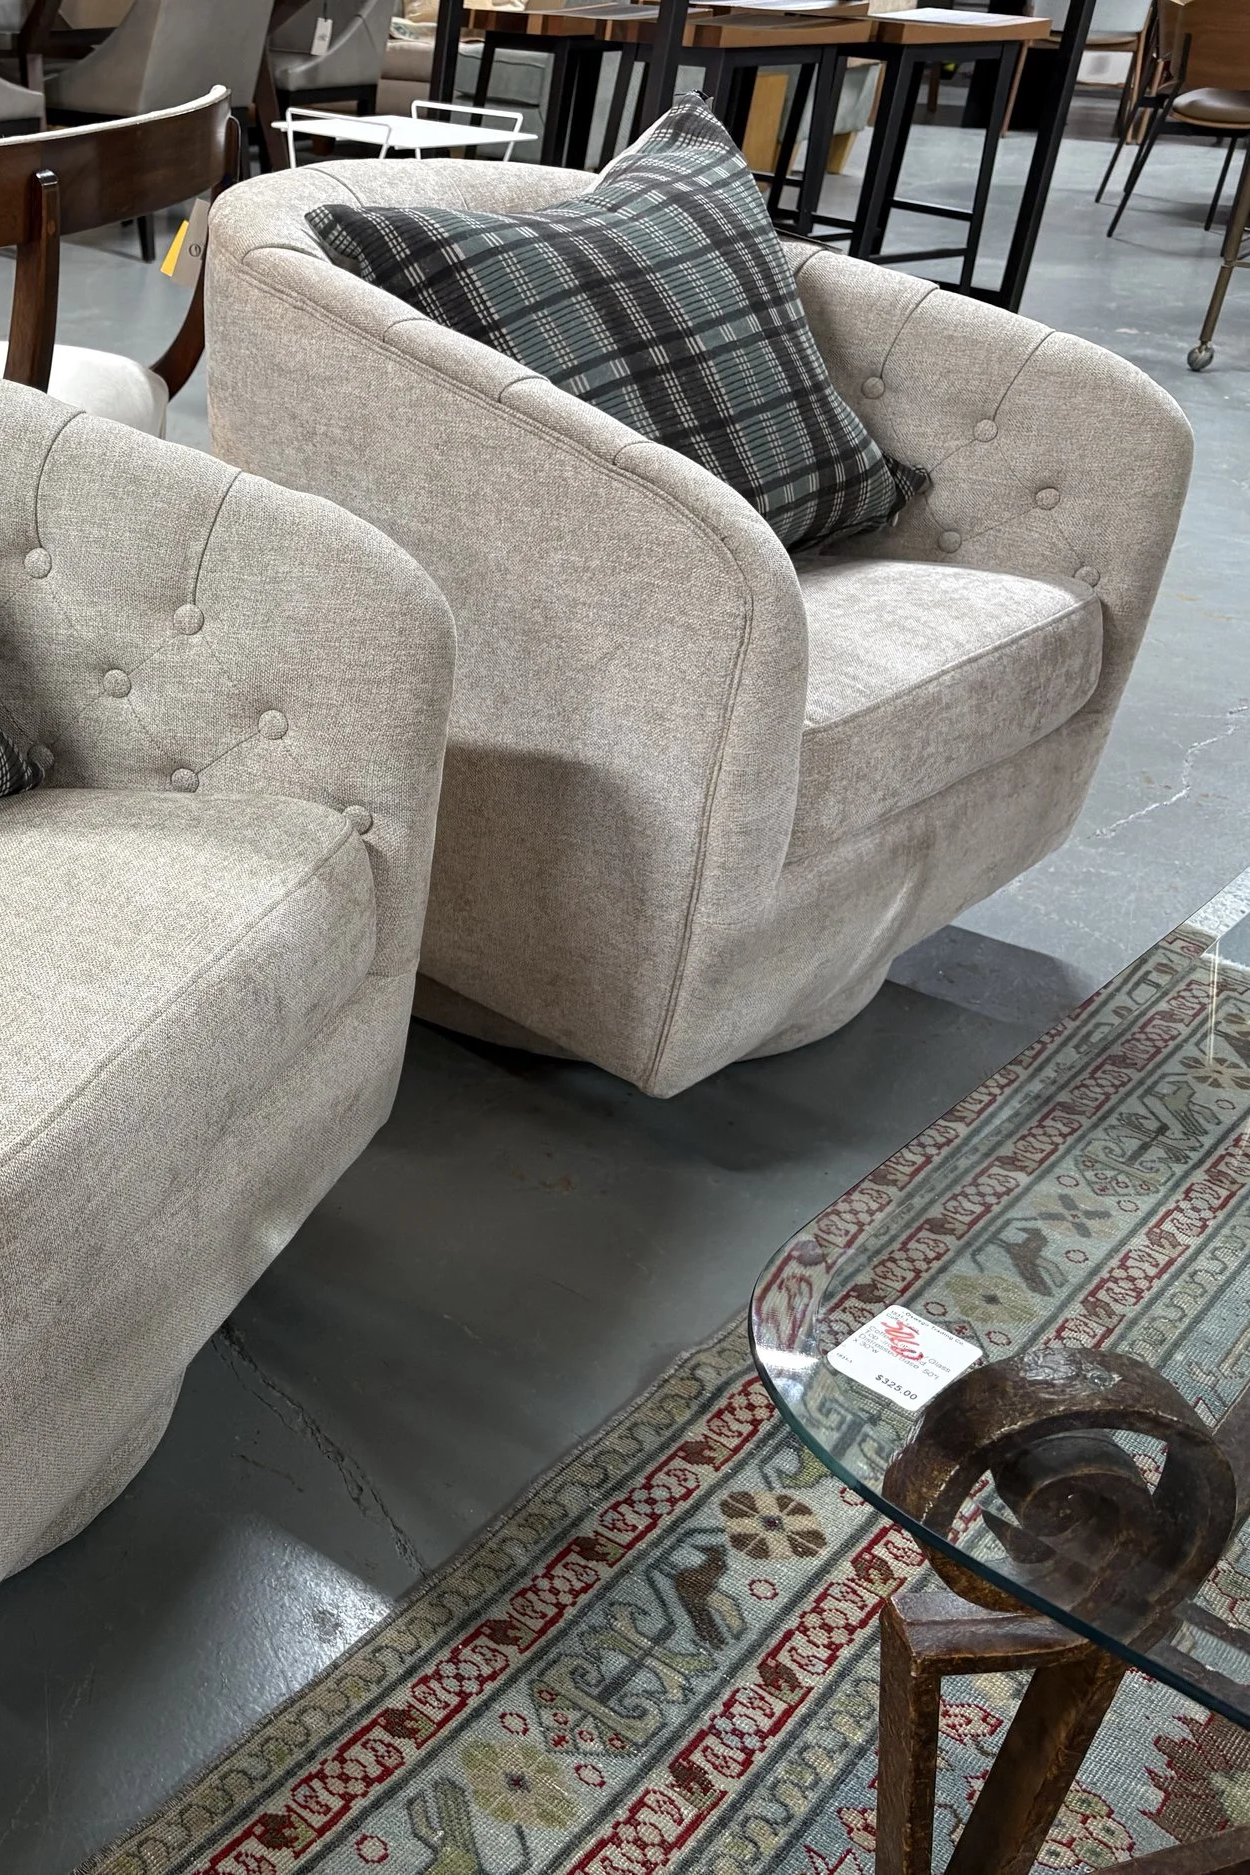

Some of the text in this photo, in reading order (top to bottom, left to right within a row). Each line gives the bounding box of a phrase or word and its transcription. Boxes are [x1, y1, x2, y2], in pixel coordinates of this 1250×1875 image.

[865, 1329, 879, 1341] Top
[930, 1325, 954, 1340] Trading
[874, 1373, 918, 1401] $325.00
